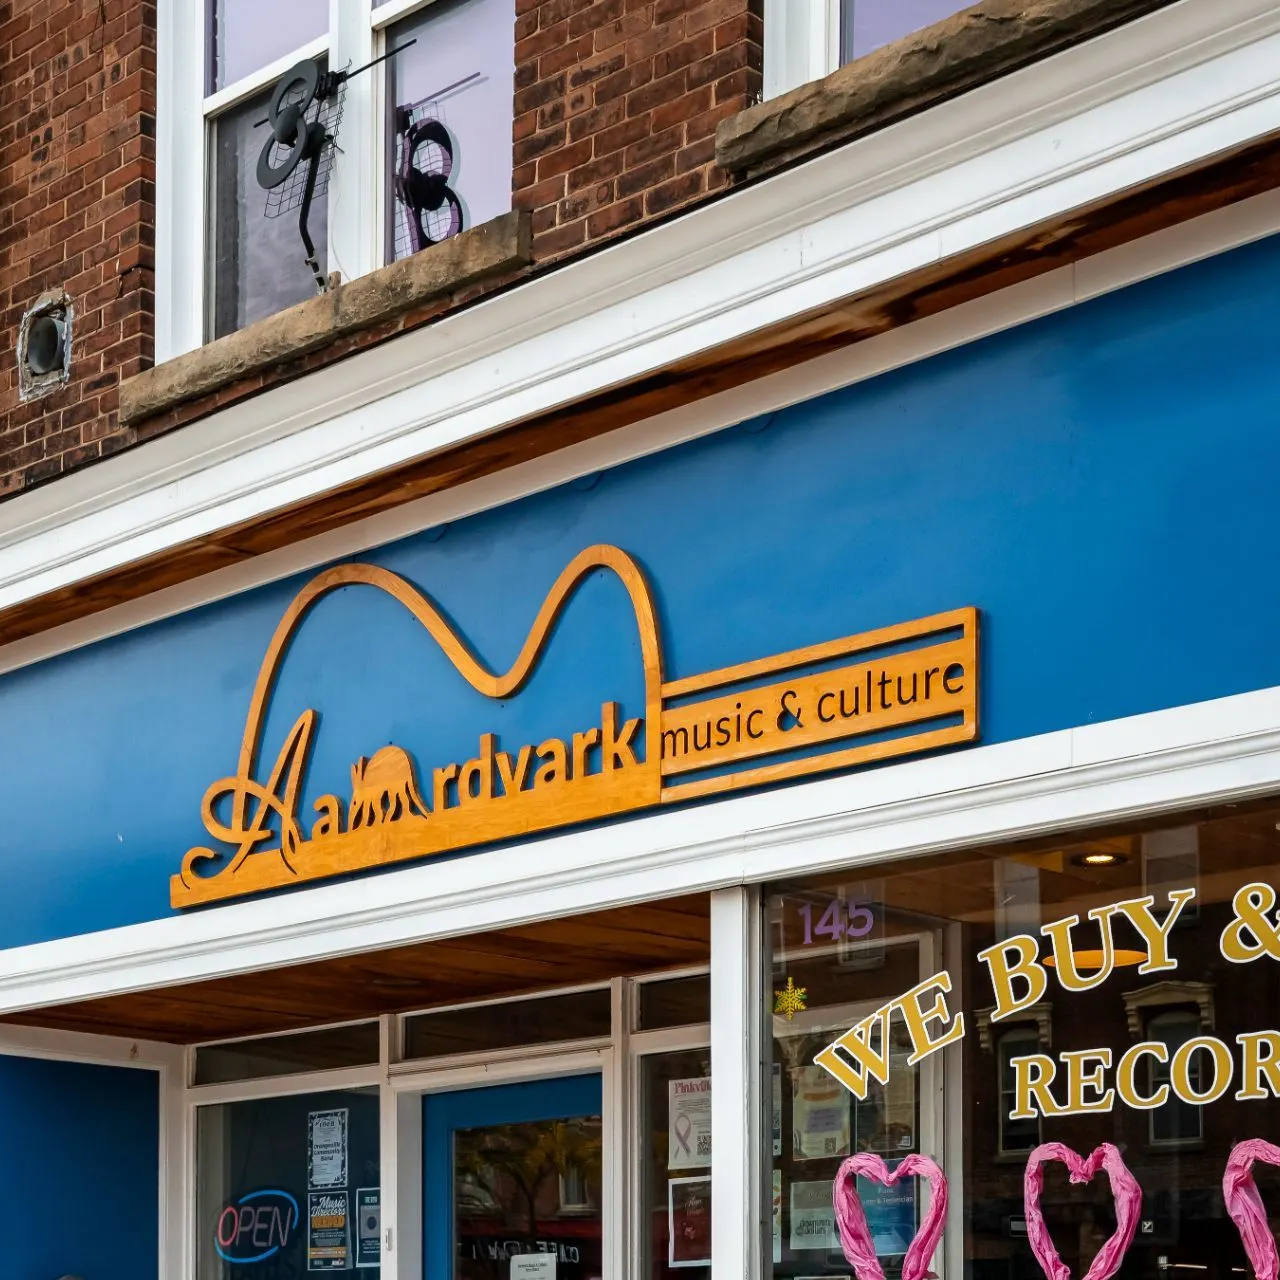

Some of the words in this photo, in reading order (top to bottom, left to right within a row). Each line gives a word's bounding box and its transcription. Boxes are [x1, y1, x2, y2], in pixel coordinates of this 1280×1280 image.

[660, 704, 764, 759] music
[776, 690, 803, 728] &
[817, 661, 965, 724] culture
[798, 899, 874, 944] 145
[813, 970, 965, 1100] WE
[977, 886, 1196, 1023] BUY
[675, 1081, 711, 1096] Pinkvill
[218, 1206, 292, 1247] OPEN
